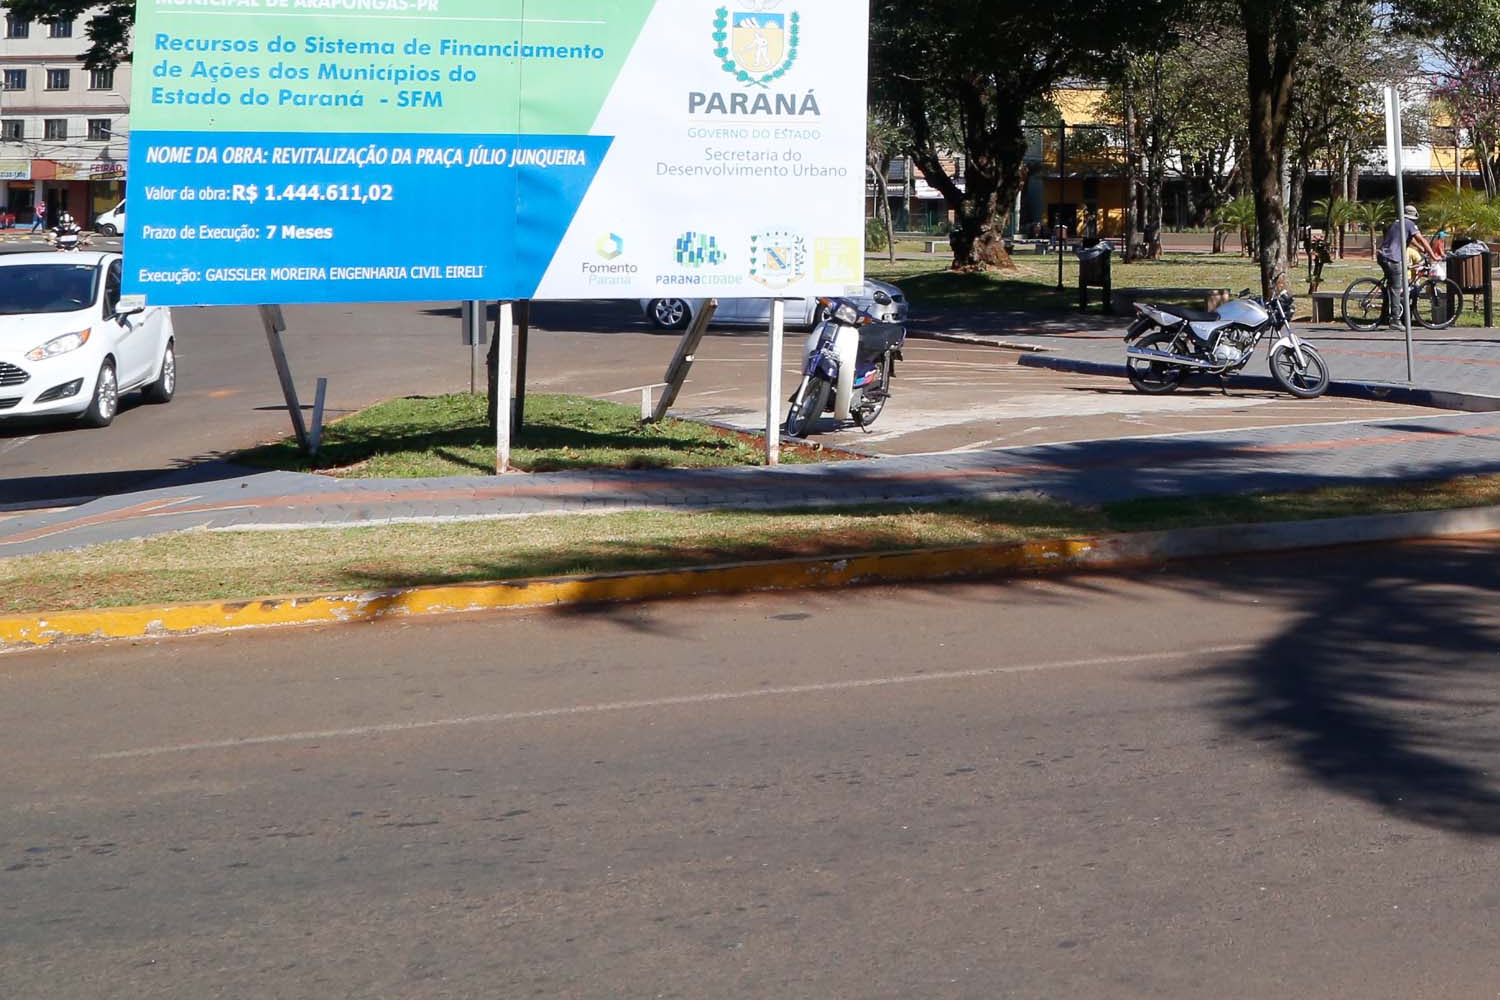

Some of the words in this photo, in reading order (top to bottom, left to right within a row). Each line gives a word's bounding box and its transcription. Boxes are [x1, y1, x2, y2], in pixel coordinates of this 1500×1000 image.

[154, 34, 258, 53] Recursos
[267, 35, 296, 53] do
[304, 36, 395, 55] Sistema
[403, 38, 431, 56] de
[440, 39, 605, 59] Financiamento
[152, 60, 182, 78] de
[190, 61, 260, 83] Ações
[268, 62, 310, 80] dos
[318, 63, 440, 85] Municípios
[449, 65, 476, 82] do
[151, 87, 231, 105] Estado
[240, 88, 269, 106] do
[279, 89, 364, 107] Paraná
[396, 91, 443, 108] SFM
[688, 89, 821, 116] PARANÁ
[687, 128, 747, 139] GOVERNO
[752, 128, 770, 139] DO
[774, 128, 821, 139] ESTADO
[146, 147, 192, 163] NOME
[196, 148, 217, 163] DA
[222, 148, 268, 164] OBRA:
[272, 145, 388, 168] REVITALIZAÇÃO
[391, 149, 411, 164] DA
[416, 149, 463, 168] PRAÇA
[465, 145, 506, 168] JÚLIO
[508, 149, 586, 168] JUNQUEIRA
[704, 148, 778, 161] Secretaria
[782, 148, 802, 162] do
[656, 162, 788, 176] Desenvolvimento
[793, 163, 847, 176] Urbano
[145, 186, 176, 200] Valor
[180, 186, 195, 200] da
[199, 187, 231, 200] obra:
[232, 184, 258, 204] R$
[265, 185, 393, 204] 1.444.611,02
[143, 225, 176, 239] Prazo
[180, 225, 195, 239] de
[200, 224, 259, 242] Execução:
[266, 225, 277, 239] 7
[282, 225, 333, 239] Meses
[139, 268, 201, 284] Execução:
[205, 268, 266, 281] GAISSLER
[270, 267, 326, 280] MOREIRA
[330, 267, 407, 280] ENGENHARIA
[411, 266, 442, 279] CIVIL
[446, 266, 483, 279] EIRELI
[582, 262, 638, 273] Fomento
